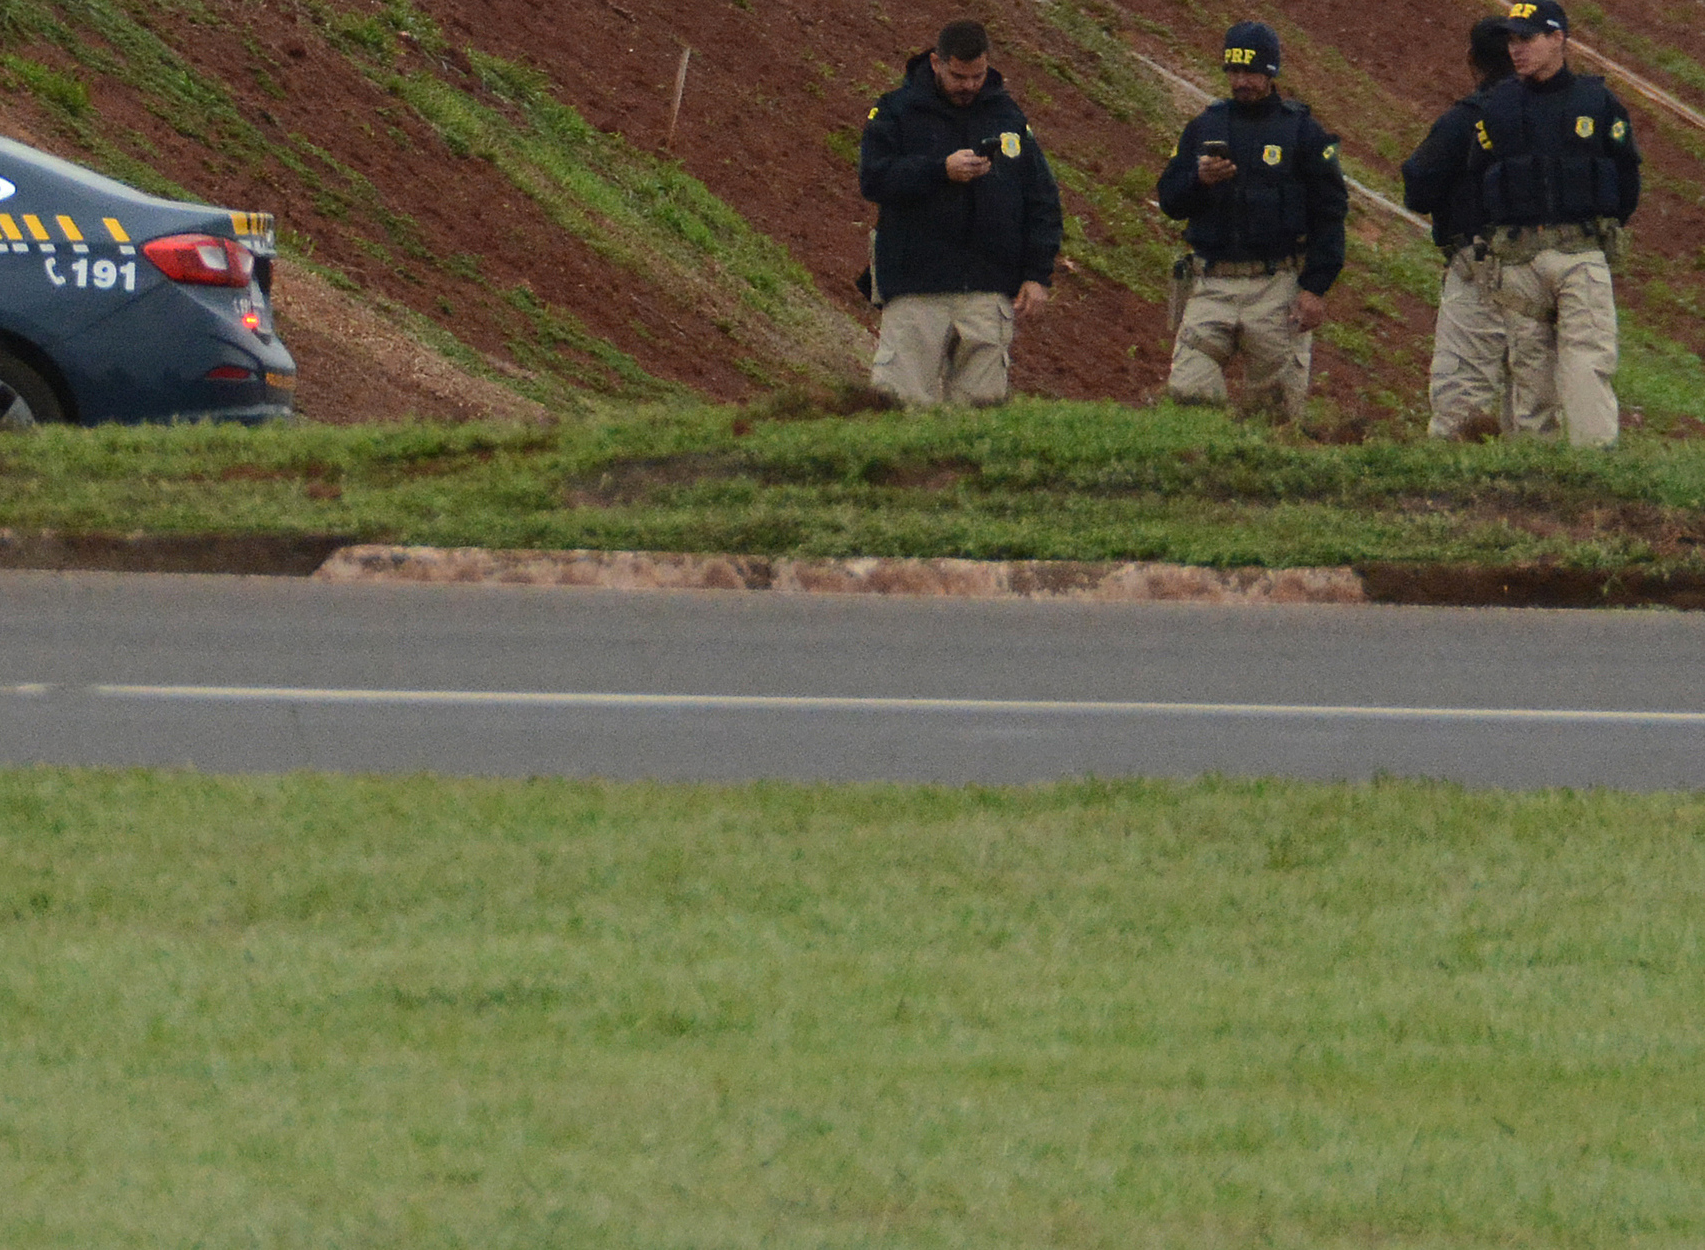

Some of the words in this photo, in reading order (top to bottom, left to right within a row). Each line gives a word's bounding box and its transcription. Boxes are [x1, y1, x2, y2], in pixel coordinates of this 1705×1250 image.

[1509, 3, 1537, 19] RF
[1225, 47, 1257, 65] PRF
[71, 257, 137, 292] 191
